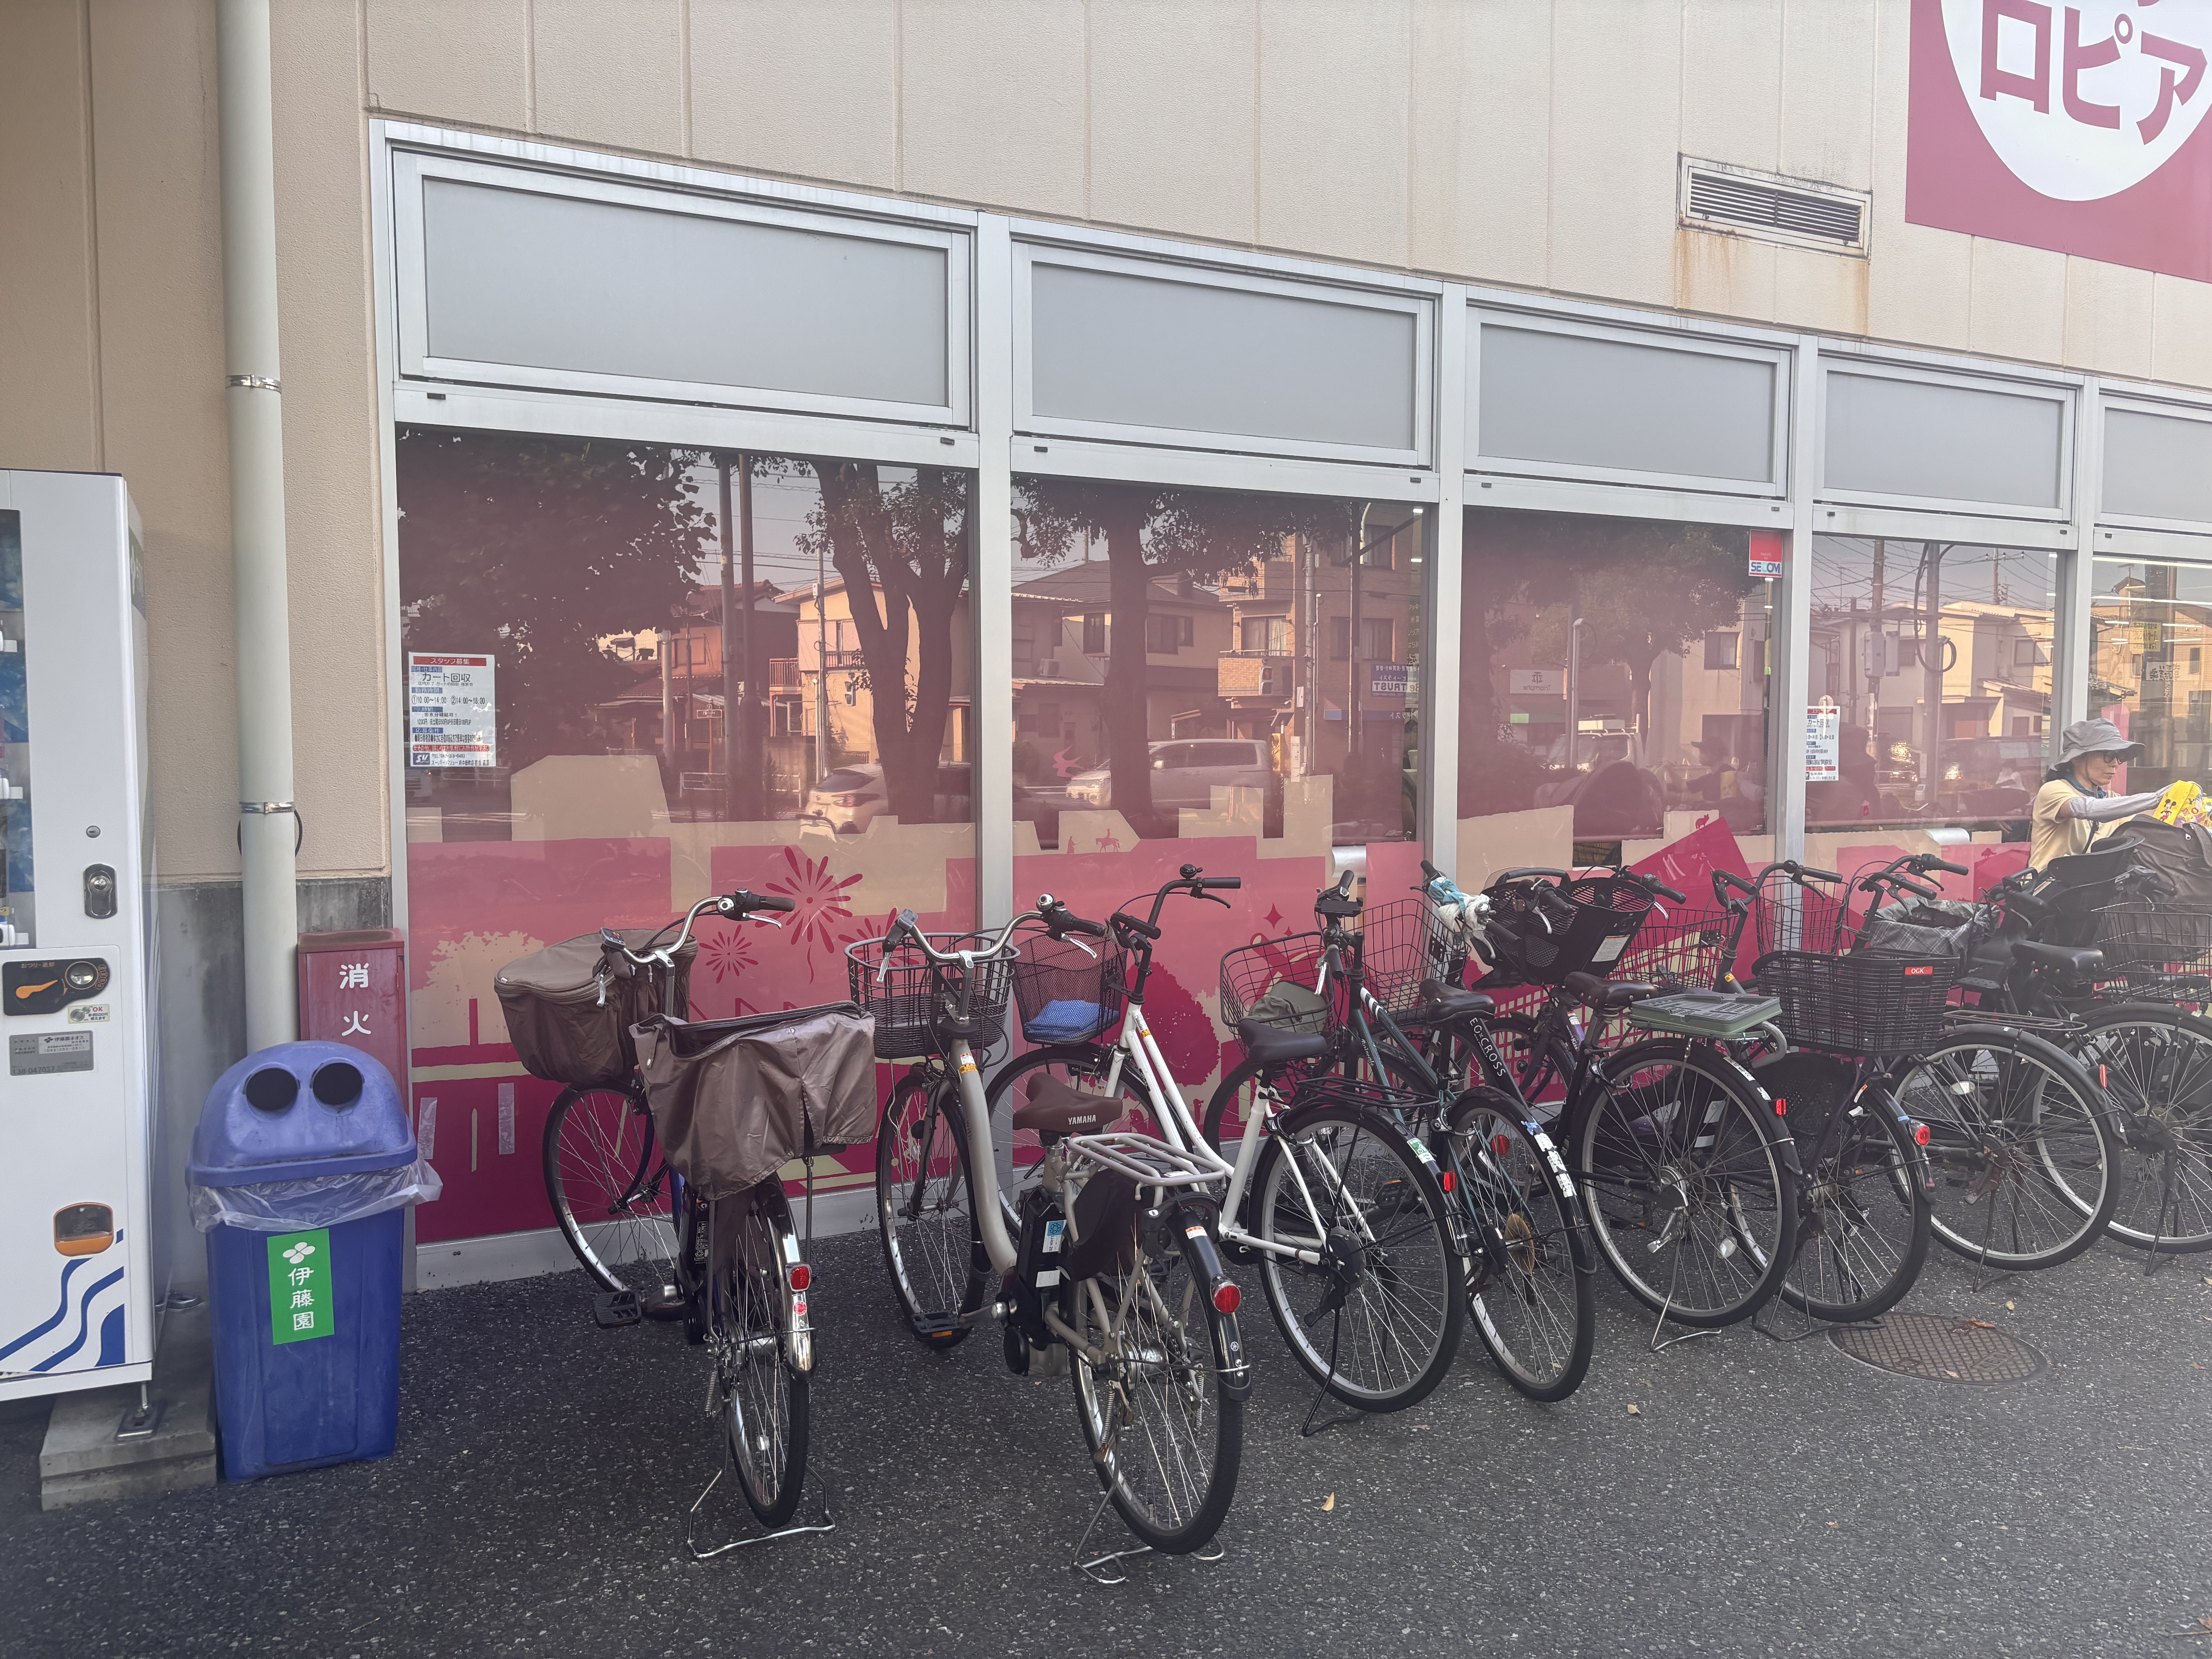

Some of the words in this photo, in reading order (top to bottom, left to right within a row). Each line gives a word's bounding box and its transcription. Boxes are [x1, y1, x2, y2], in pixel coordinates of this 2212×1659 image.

[1980, 0, 2208, 145] ロピア
[1751, 562, 1780, 574] SECOM
[422, 673, 471, 682] カート回収
[339, 963, 372, 1037] 消火
[1068, 1115, 1096, 1125] YAMAHA
[287, 1266, 314, 1331] 伊藤園
